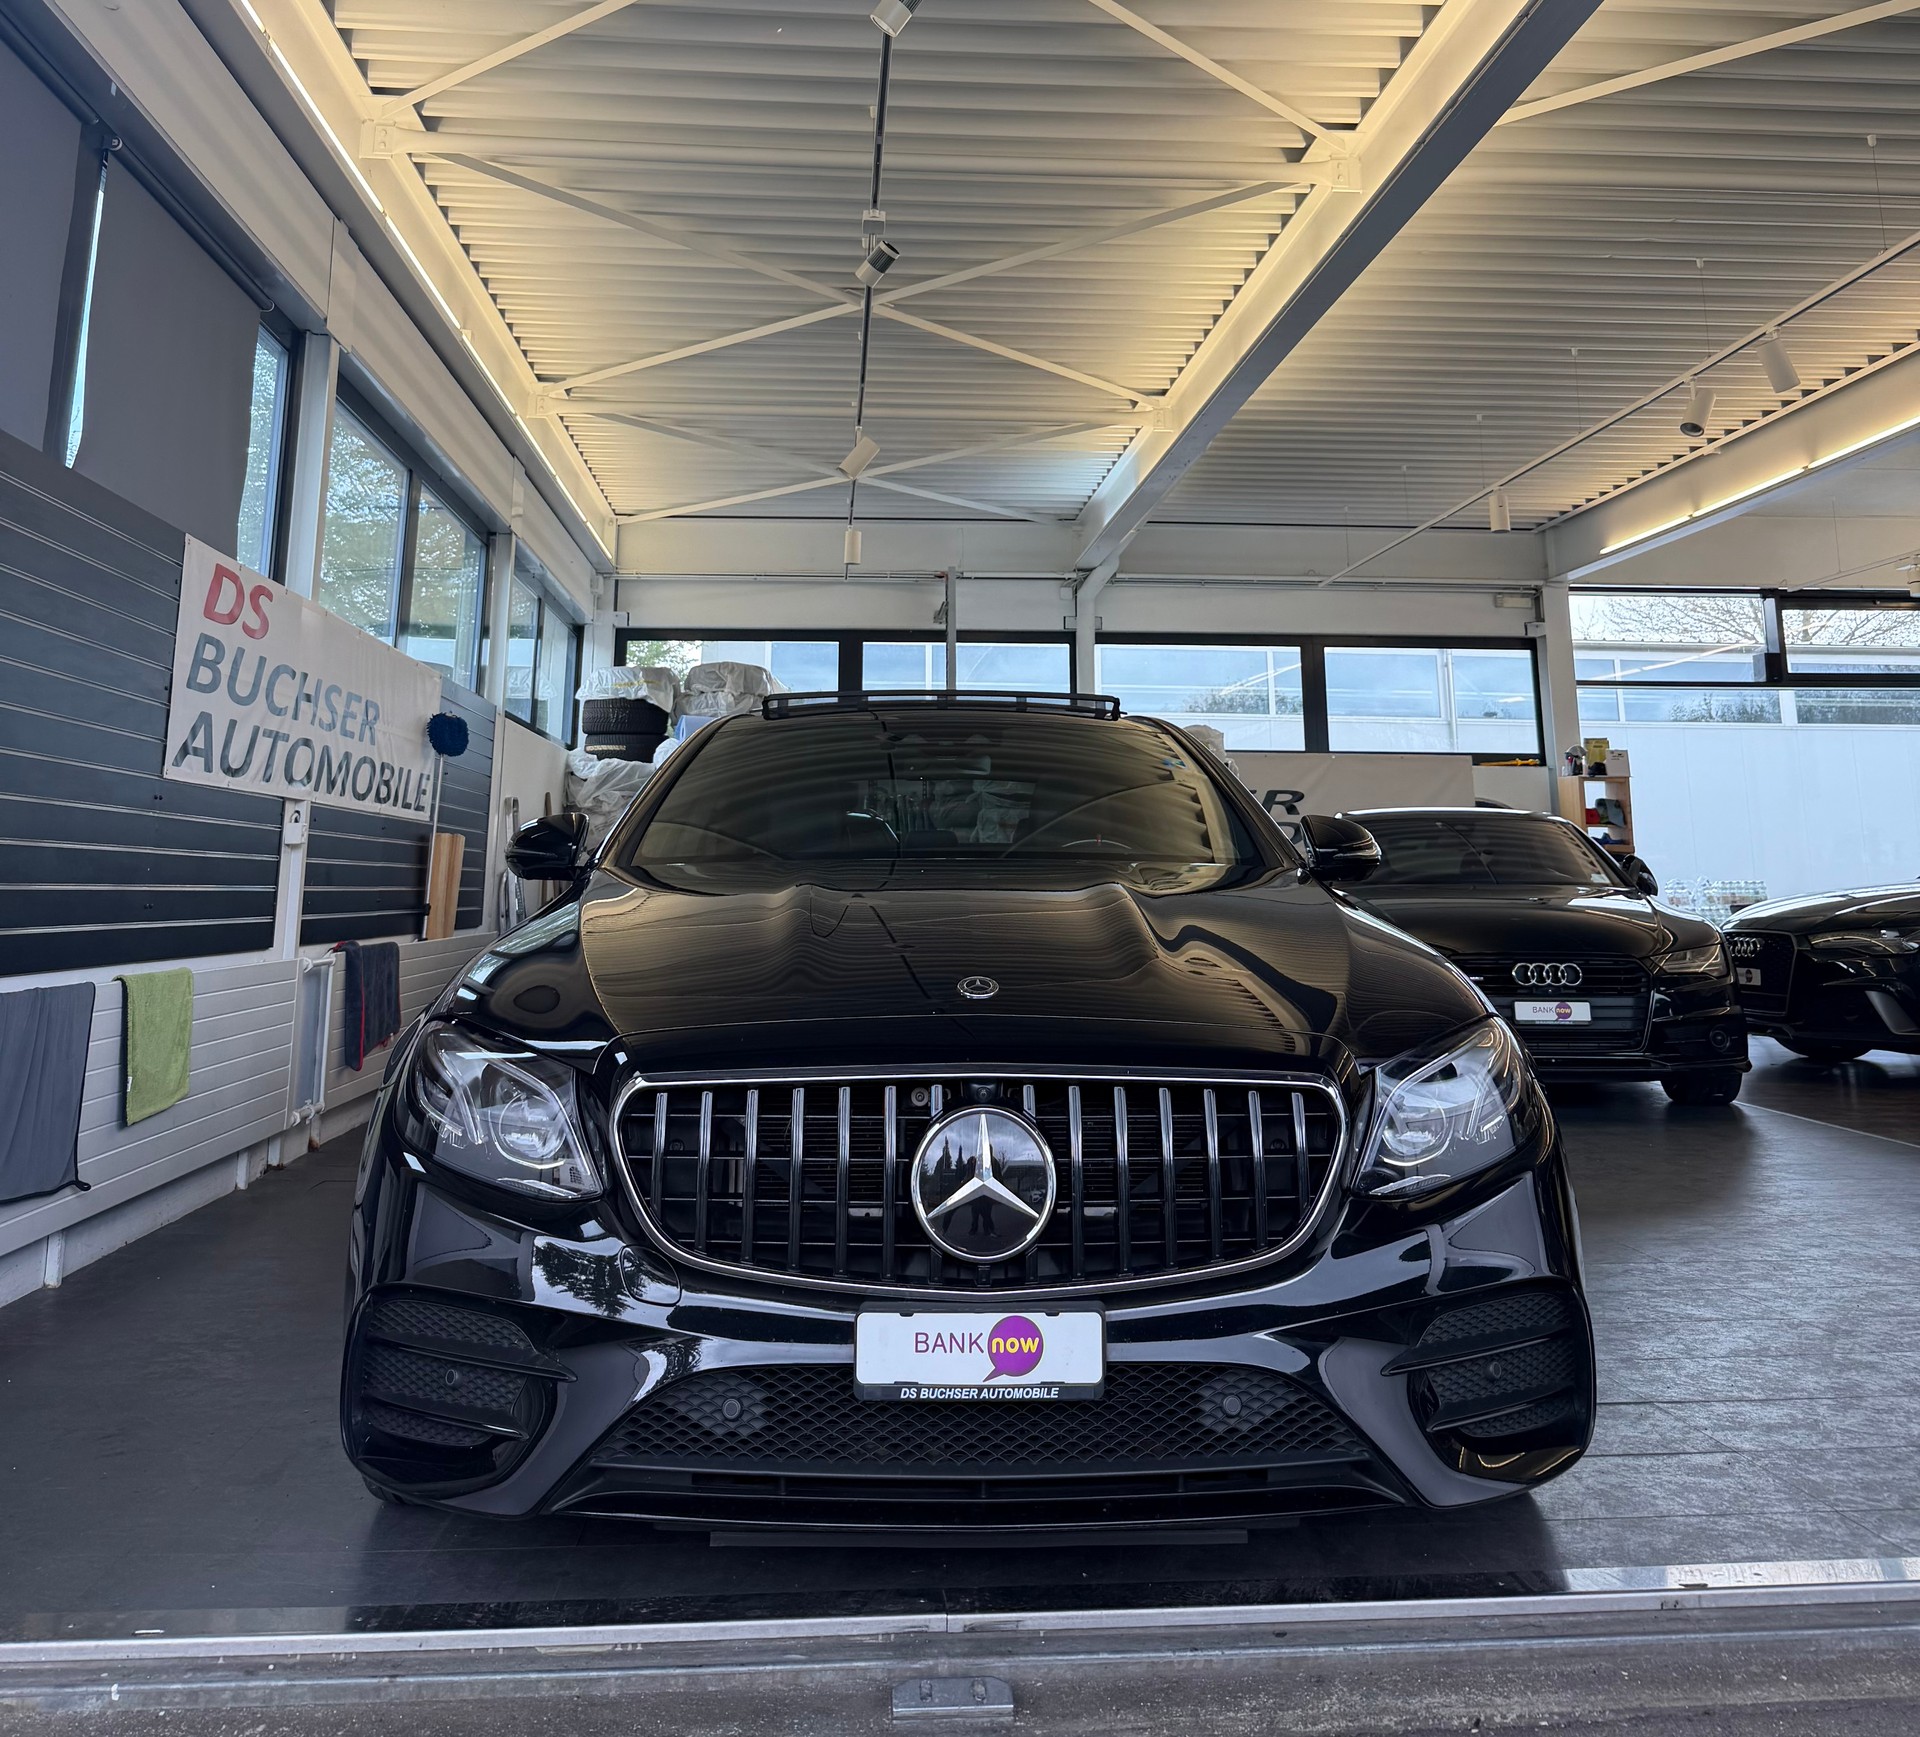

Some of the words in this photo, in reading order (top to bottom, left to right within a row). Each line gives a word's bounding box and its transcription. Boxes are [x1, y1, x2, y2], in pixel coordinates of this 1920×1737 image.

[203, 562, 274, 640] DS
[185, 632, 381, 746] BUCHSER
[171, 711, 431, 812] AUTOMOBILE
[914, 1332, 985, 1354] BANK
[991, 1337, 1040, 1354] now
[900, 1387, 918, 1399] DS
[920, 1387, 979, 1399] BUCHSER
[979, 1387, 1060, 1399] AUTOMOBILE
